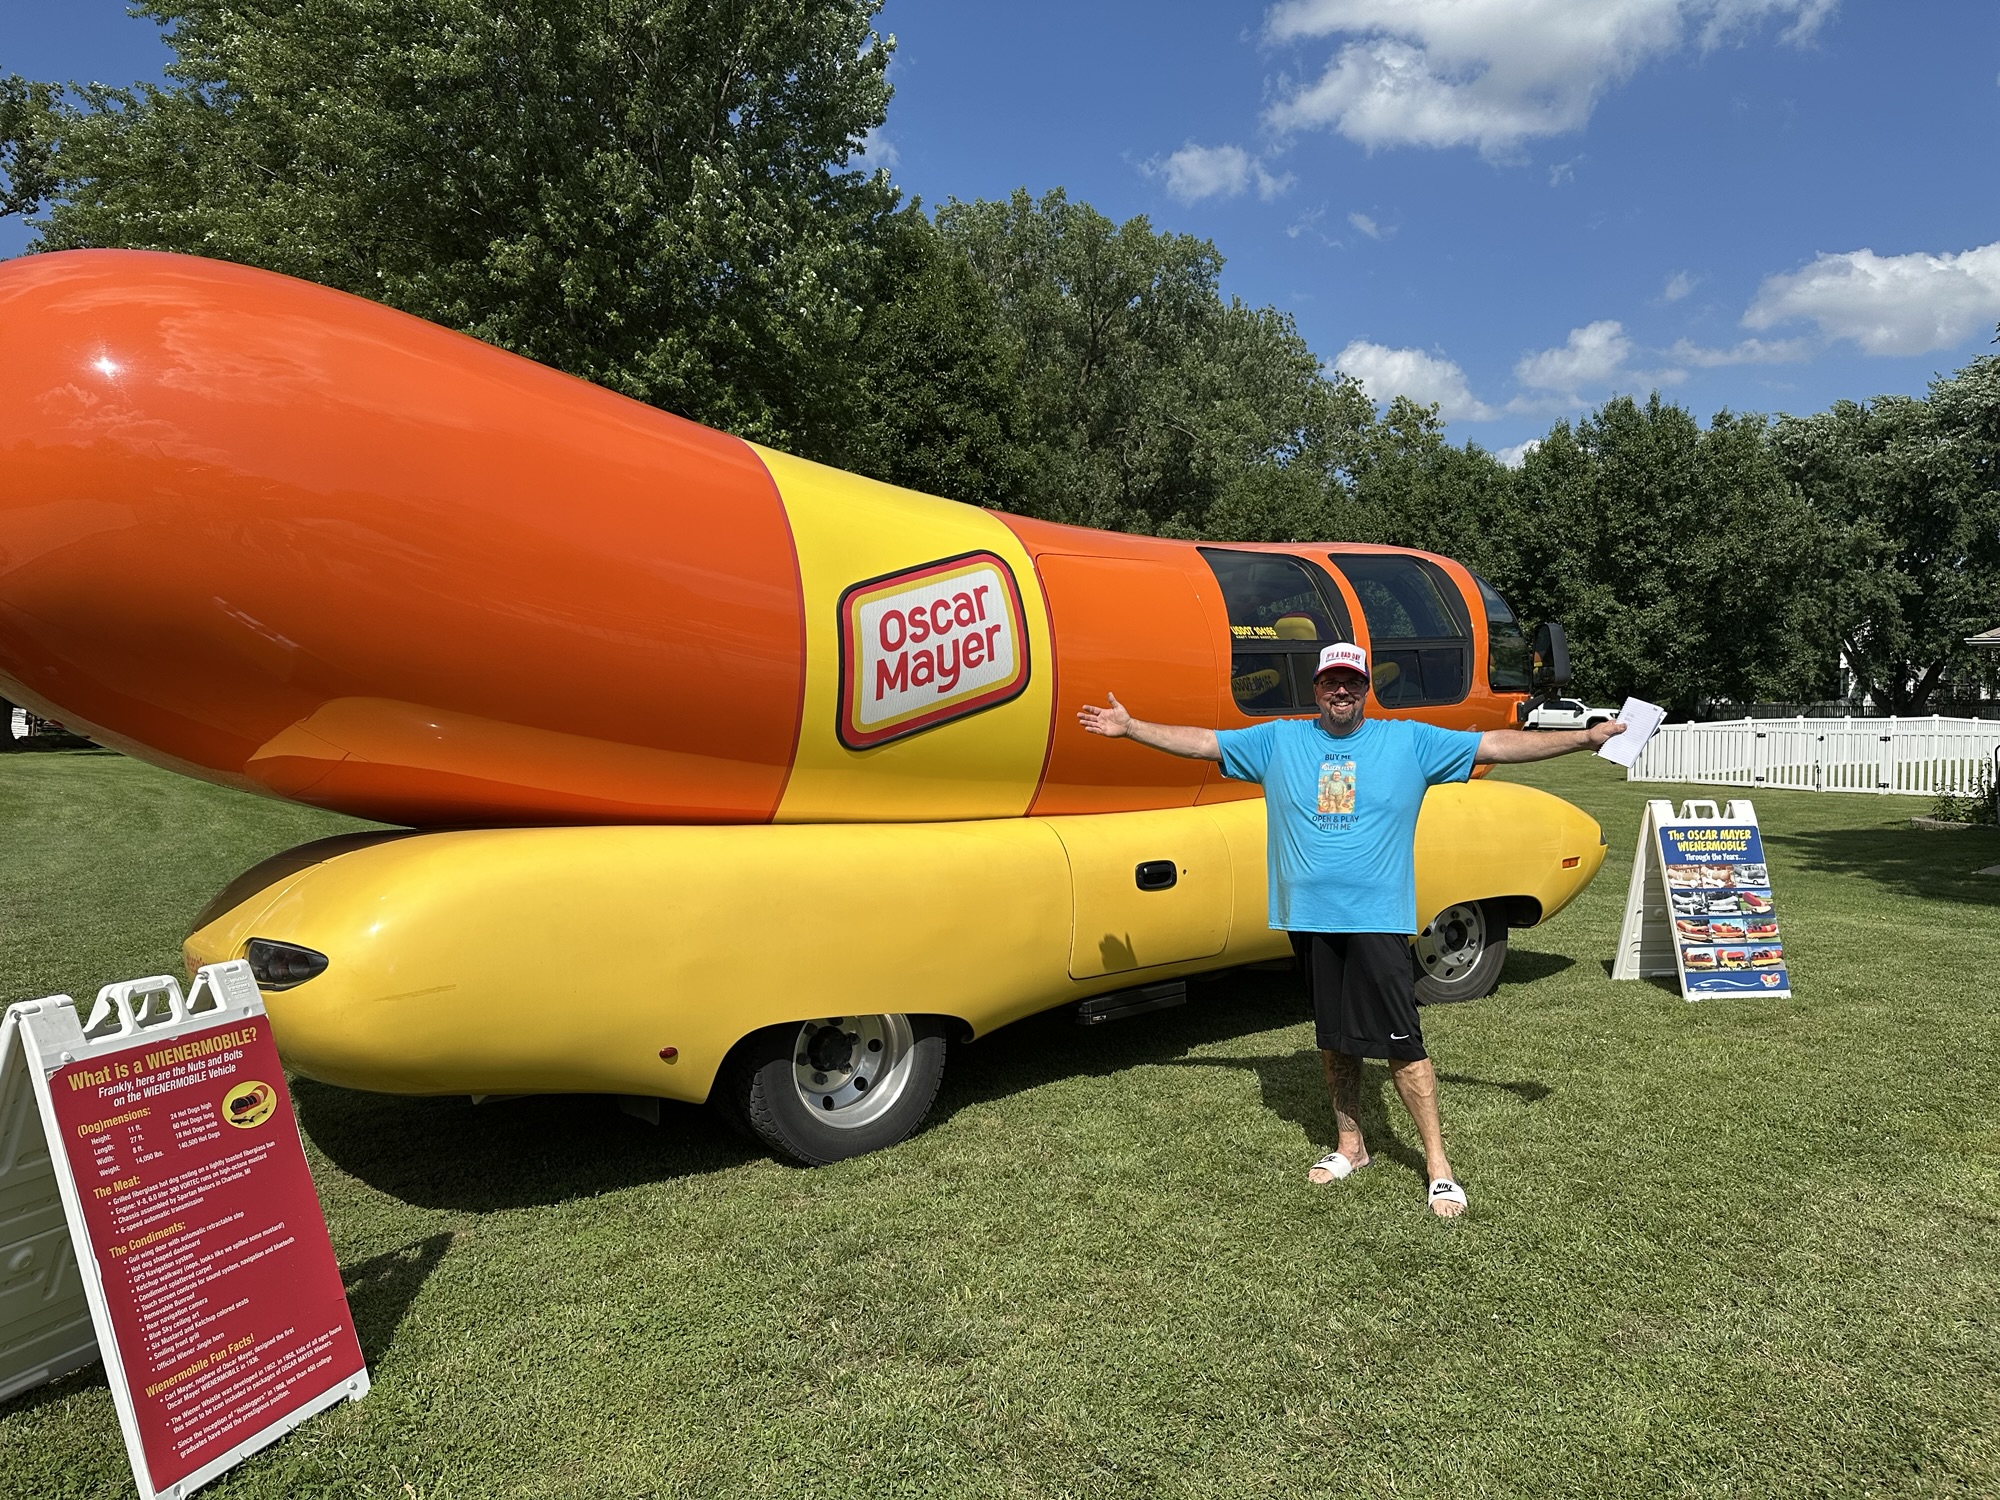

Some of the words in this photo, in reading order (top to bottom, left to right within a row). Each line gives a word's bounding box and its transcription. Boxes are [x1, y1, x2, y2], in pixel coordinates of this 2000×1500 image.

[879, 585, 988, 652] Oscar
[1230, 626, 1254, 636] USDOT
[875, 624, 1000, 701] Mayer
[1668, 830, 1685, 840] The
[1687, 830, 1718, 840] OSCAR
[1720, 830, 1752, 840] MAYER
[1677, 841, 1747, 852] WIENERMOBILE
[1685, 853, 1710, 862] Through
[67, 1065, 111, 1091] What
[114, 1062, 129, 1078] is
[132, 1060, 143, 1074] a
[145, 1026, 256, 1069] WIENERMOBILE?
[98, 1080, 134, 1098] Frankly,
[135, 1075, 154, 1087] here
[156, 1070, 170, 1081] are
[172, 1066, 185, 1076] the
[187, 1060, 206, 1072] Nuts
[207, 1054, 222, 1067] and
[223, 1049, 243, 1062] Bolts
[113, 1096, 125, 1107] on
[126, 1091, 141, 1103] the
[143, 1070, 206, 1098] WIENERMOBILE
[208, 1063, 236, 1078] Vehicle
[77, 1107, 151, 1138] (Dog)mensions:
[177, 1109, 187, 1117] Hot
[186, 1106, 200, 1114] Dogs
[200, 1101, 212, 1110] high
[179, 1119, 189, 1127] Hot
[189, 1115, 202, 1124] Dogs
[90, 1133, 111, 1145] Height:
[129, 1135, 136, 1143] 27
[182, 1128, 192, 1136] Hot
[191, 1125, 205, 1133] Dogs
[205, 1120, 217, 1129] wide
[197, 1134, 207, 1142] Hot
[207, 1131, 220, 1139] Dogs
[93, 1144, 115, 1155] Length:
[95, 1155, 115, 1165] Width:
[135, 1152, 153, 1164] 14,050
[98, 1164, 120, 1176] Weight:
[93, 1186, 112, 1199] The
[112, 1175, 140, 1192] Meat:
[115, 1202, 136, 1214] Engine:
[147, 1193, 157, 1202] 6.0
[168, 1185, 179, 1194] 300
[200, 1174, 212, 1182] runs
[1436, 1182, 1454, 1191] NIKE
[117, 1211, 139, 1224] Chassis
[140, 1198, 169, 1215] assembled
[176, 1189, 197, 1201] Spartan
[197, 1182, 215, 1193] Motors
[120, 1219, 143, 1233] 6-speed
[170, 1196, 204, 1213] transmission
[109, 1245, 127, 1258] The
[128, 1221, 186, 1250] Condiments:
[140, 1248, 154, 1258] wing
[154, 1243, 166, 1252] door
[167, 1237, 180, 1247] with
[130, 1263, 141, 1273] Hot
[141, 1260, 152, 1268] dog
[152, 1250, 172, 1264] shaped
[173, 1238, 200, 1255] dashboard
[133, 1272, 145, 1282] GPS
[145, 1261, 174, 1277] Navigation
[174, 1252, 194, 1265] system
[138, 1283, 168, 1302] Condiment
[168, 1271, 195, 1288] splattered
[195, 1263, 212, 1276] carpet
[143, 1303, 173, 1321] Removable
[145, 1320, 158, 1330] Rear
[159, 1306, 188, 1324] navigation
[188, 1297, 208, 1310] camera
[148, 1330, 161, 1340] Blue
[161, 1325, 172, 1333] Sky
[191, 1310, 200, 1319] art
[150, 1341, 160, 1350] Six
[160, 1328, 183, 1345] Mustard
[184, 1323, 194, 1333] and
[194, 1314, 216, 1328] Ketchup
[235, 1297, 249, 1308] seats
[153, 1345, 174, 1359] Smiling
[174, 1337, 188, 1348] front
[156, 1355, 176, 1370] Official
[176, 1346, 195, 1360] Wiener
[196, 1338, 212, 1350] Jingle
[211, 1332, 224, 1342] horn
[145, 1358, 208, 1397] Wienermobile
[209, 1349, 227, 1363] Fun
[227, 1332, 254, 1354] Facts!
[164, 1390, 176, 1401] Carl
[176, 1381, 195, 1395] Mayer,
[216, 1365, 222, 1373] of
[222, 1358, 236, 1370] Oscar
[237, 1349, 254, 1362] Mayer,
[166, 1397, 182, 1410] Oscar
[183, 1387, 200, 1401] Mayer
[200, 1365, 240, 1391] WIENERMOBILE
